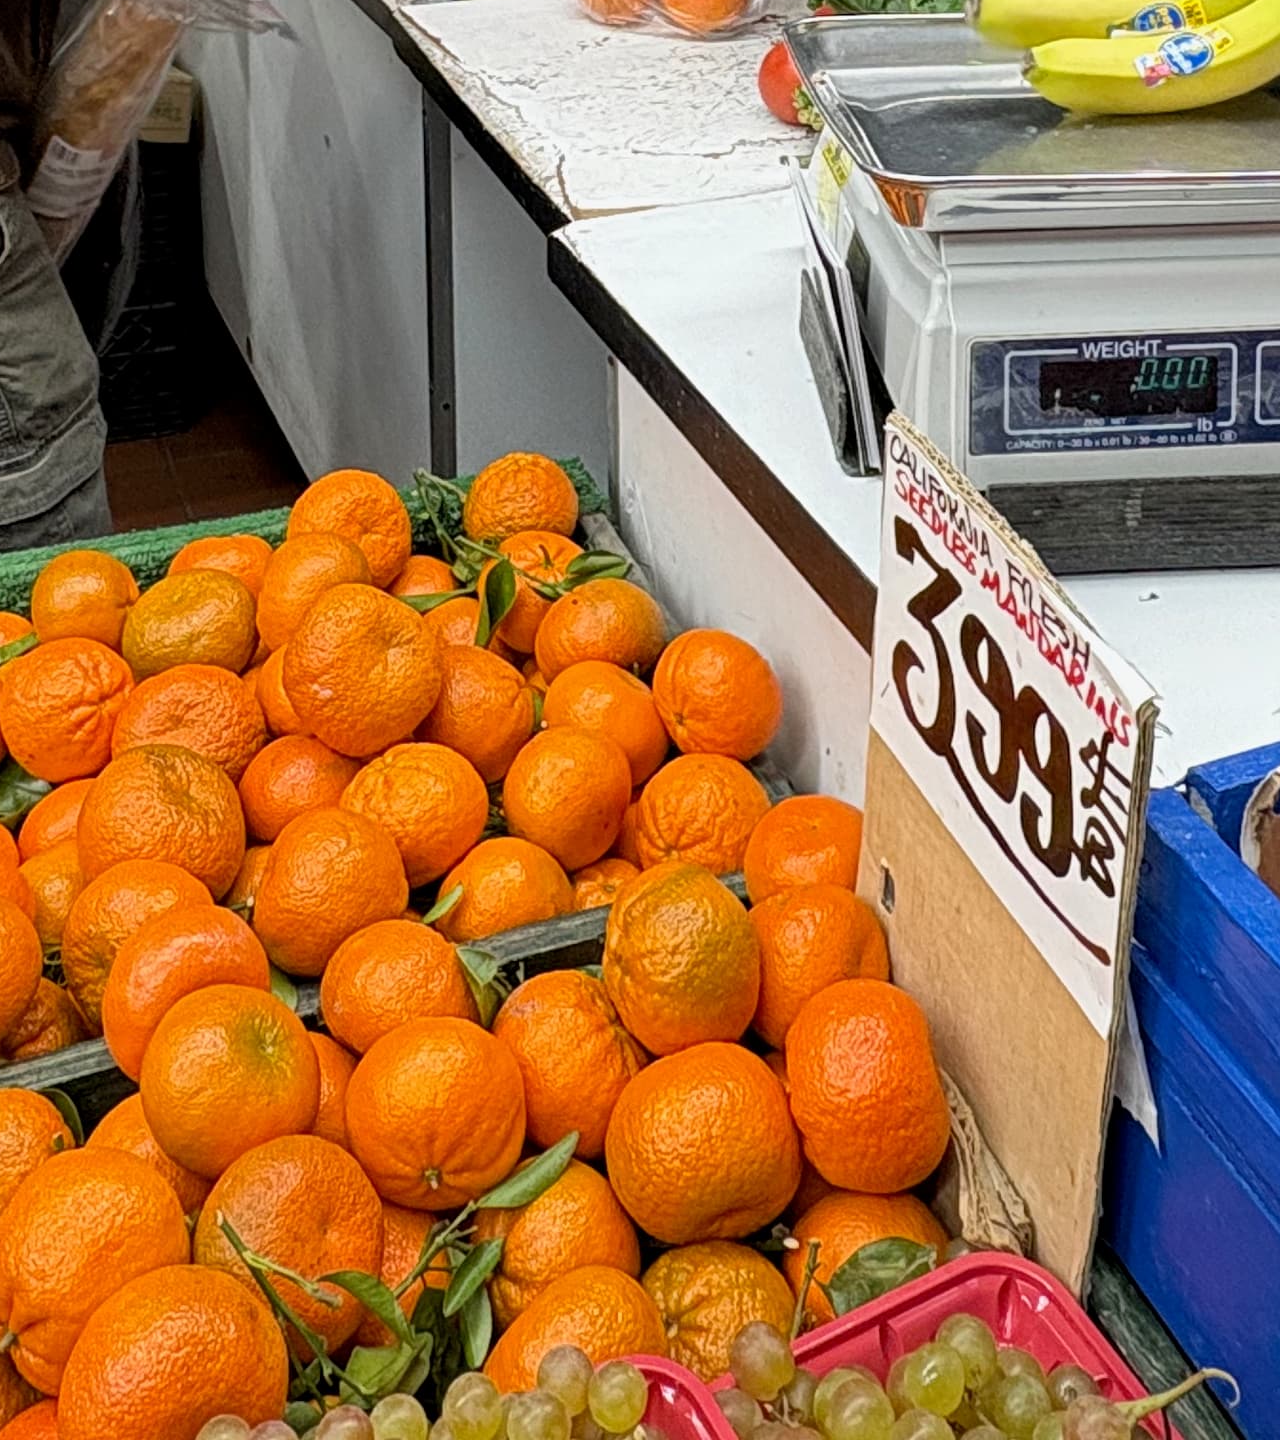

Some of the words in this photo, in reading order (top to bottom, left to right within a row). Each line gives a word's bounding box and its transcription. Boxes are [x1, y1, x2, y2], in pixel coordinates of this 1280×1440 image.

[1081, 339, 1163, 360] WEIGHT
[1196, 417, 1214, 433] lb
[887, 433, 994, 563] CALIFORNIA
[1004, 557, 1092, 670] FRESH
[893, 467, 979, 580] SEEDLESS
[979, 566, 1133, 748] MANDARINS
